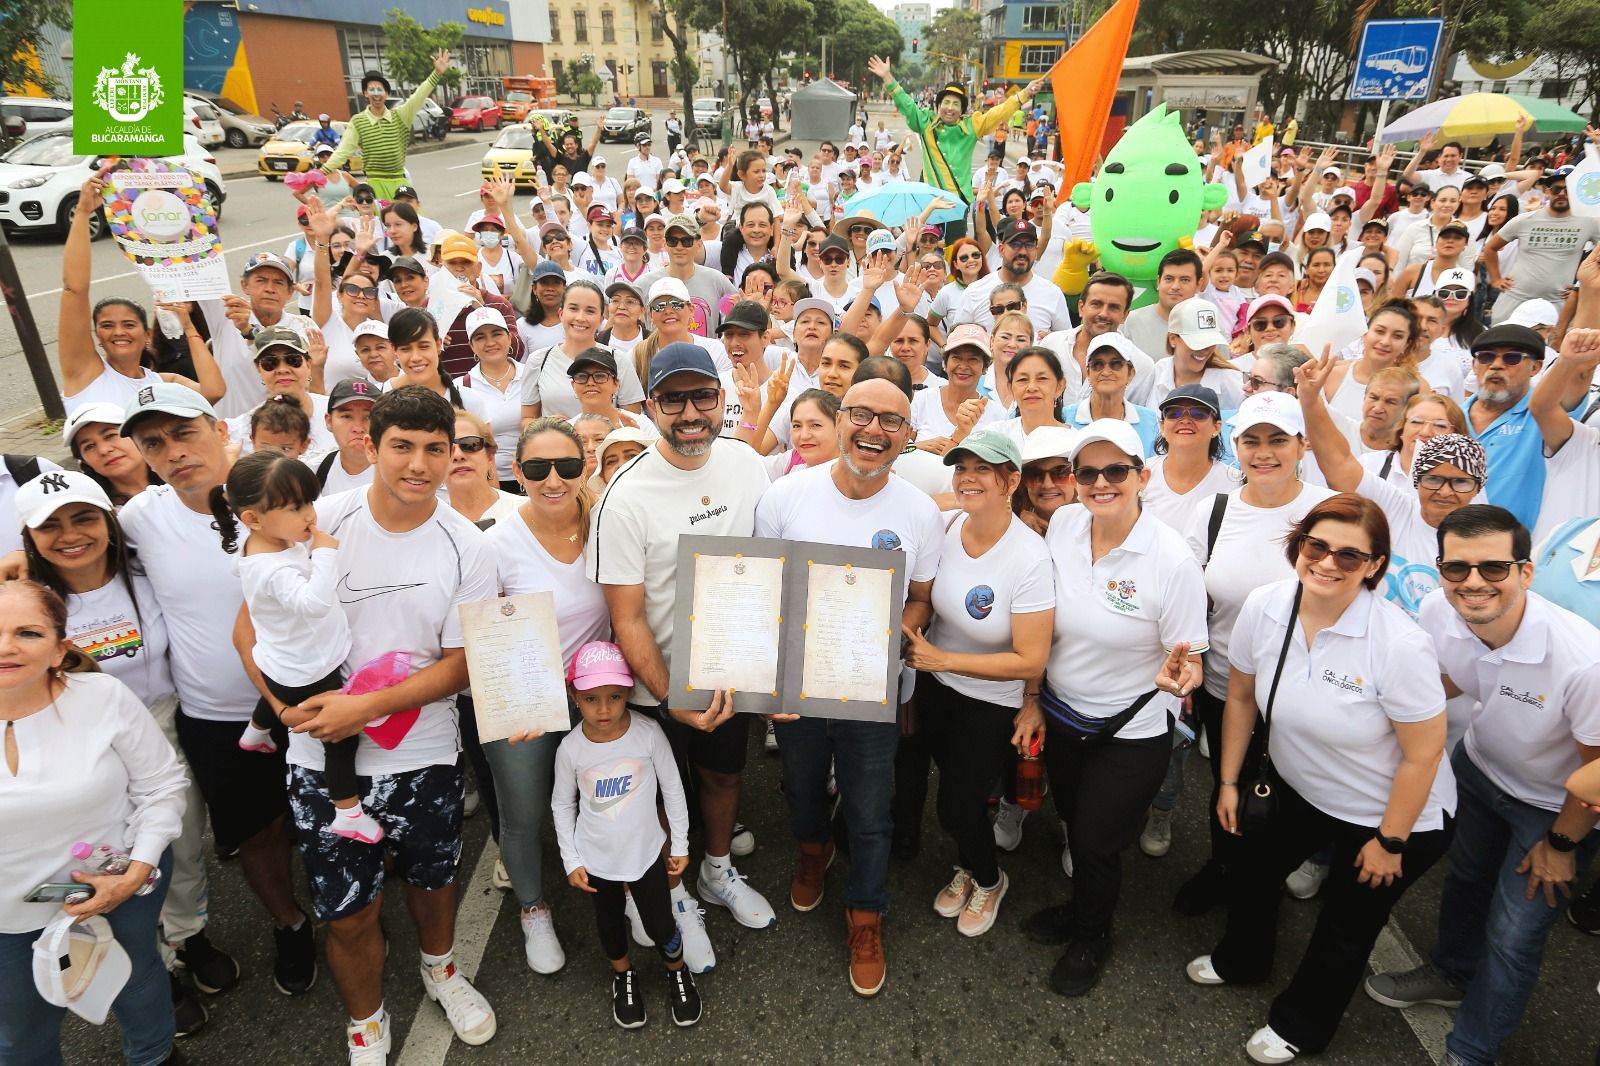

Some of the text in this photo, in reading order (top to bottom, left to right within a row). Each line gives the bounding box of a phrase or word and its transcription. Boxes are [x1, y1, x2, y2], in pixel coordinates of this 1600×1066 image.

[141, 208, 182, 227] Sanar
[40, 473, 70, 494] NY
[706, 505, 727, 519] Angels
[580, 646, 625, 668] Barbie
[1324, 669, 1337, 679] CAL
[596, 775, 632, 797] NIKE
